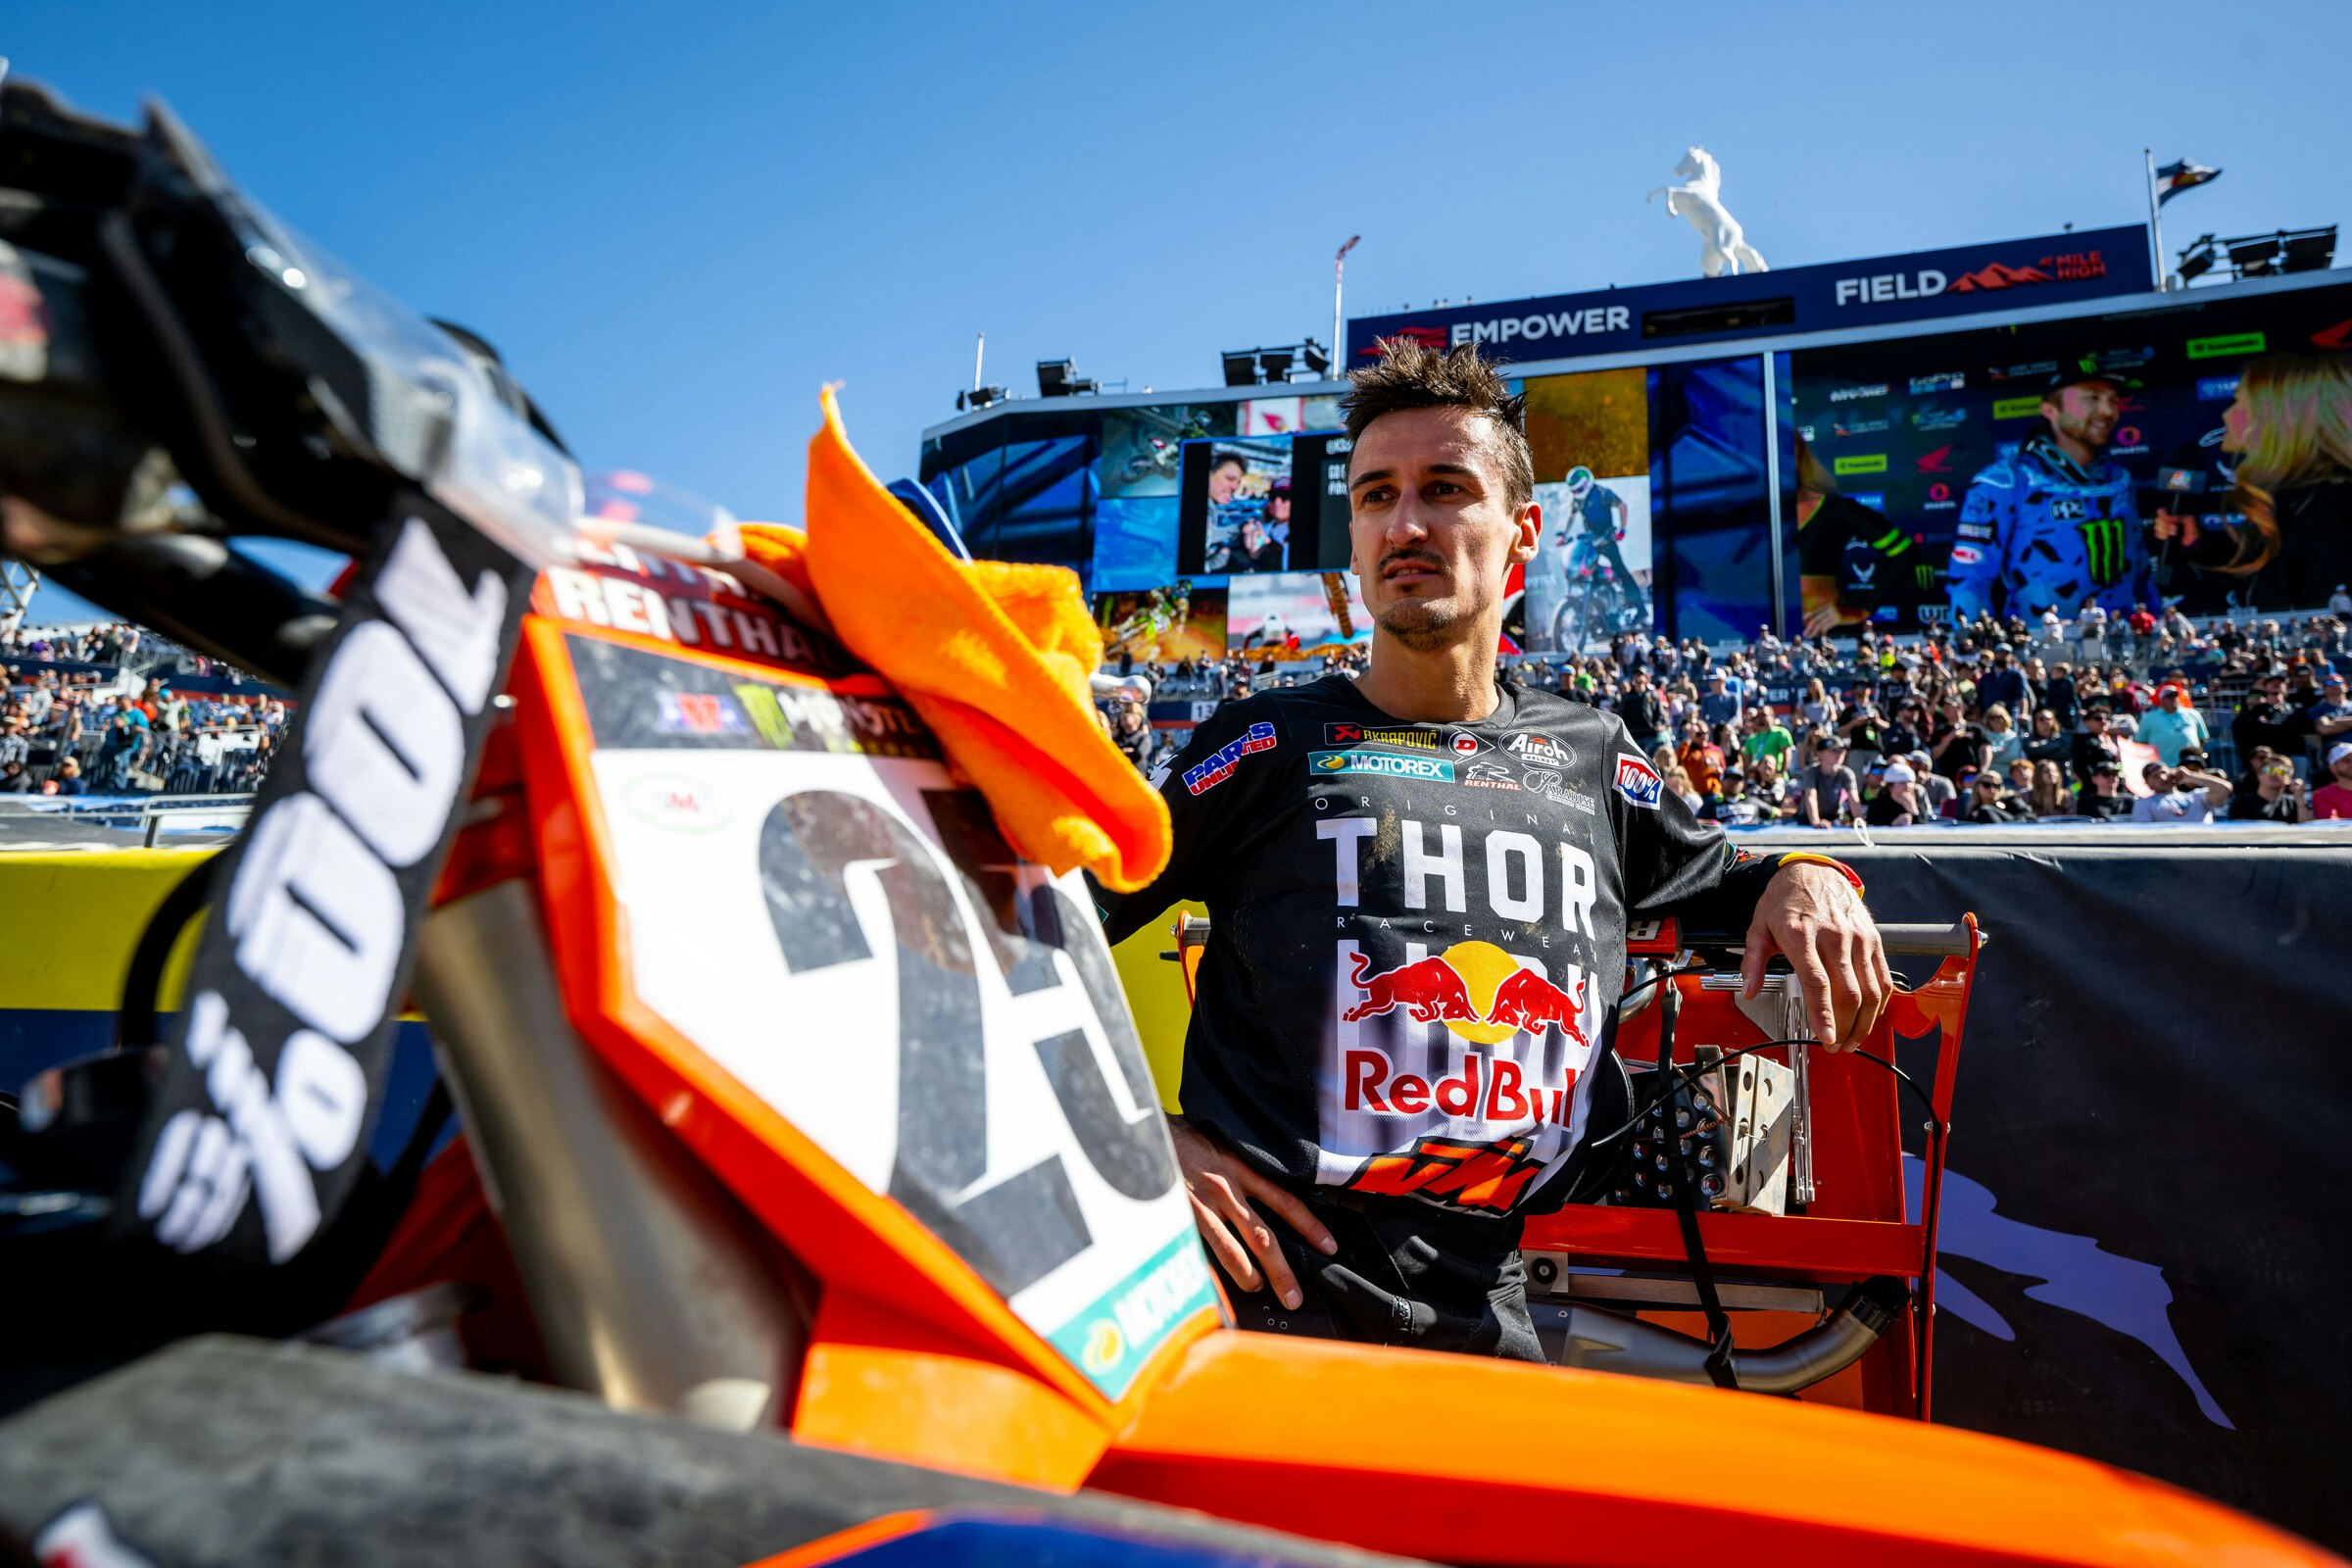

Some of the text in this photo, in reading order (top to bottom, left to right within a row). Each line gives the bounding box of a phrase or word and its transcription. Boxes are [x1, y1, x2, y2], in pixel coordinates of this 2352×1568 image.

[2055, 249, 2104, 268] MILE
[2057, 263, 2107, 281] HIGH
[1835, 269, 1948, 307] FIELD
[1451, 305, 1631, 344] EMPOWER
[547, 565, 833, 668] RENTHA
[1349, 753, 1445, 778] MOTOREX
[1621, 763, 1660, 801] 100%
[1463, 779, 1522, 792] RENTHAL
[137, 515, 509, 1266] 100%
[1315, 817, 1596, 942] THOR
[758, 789, 1177, 1305] 25
